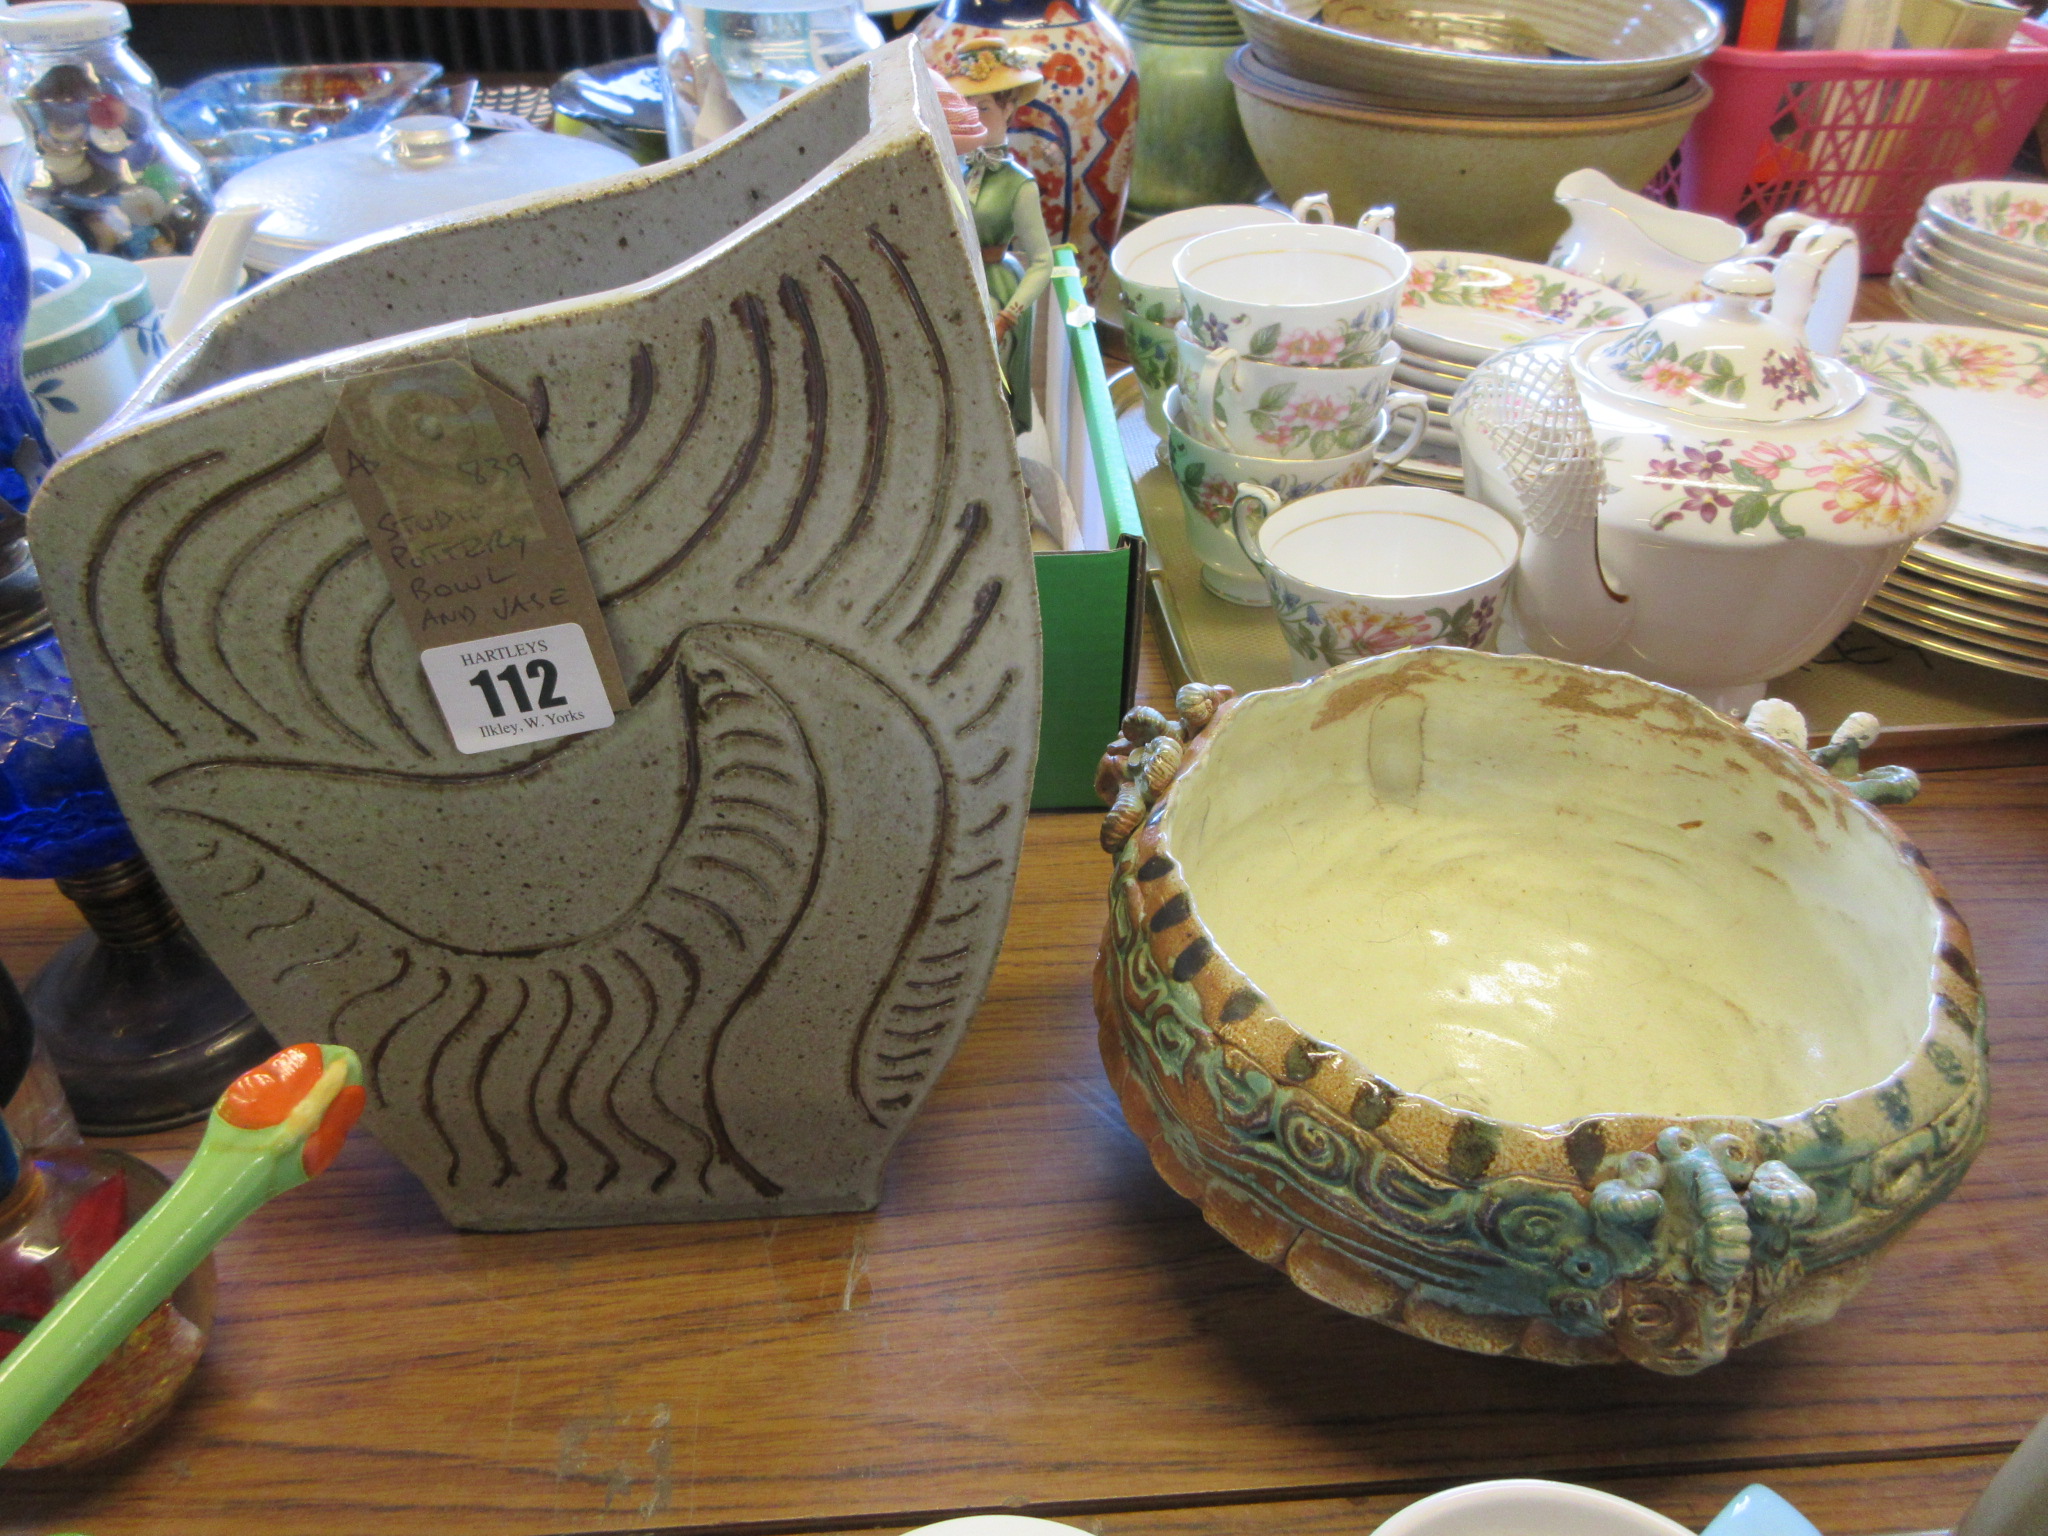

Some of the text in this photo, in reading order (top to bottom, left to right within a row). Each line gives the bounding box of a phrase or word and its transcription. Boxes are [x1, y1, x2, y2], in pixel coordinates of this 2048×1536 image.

[411, 567, 516, 602] BOWL
[422, 587, 570, 631] AND VASE
[460, 639, 548, 667] HARTLEYS
[469, 658, 569, 718] 112
[478, 709, 586, 738] Ilkley, W. Yorks
